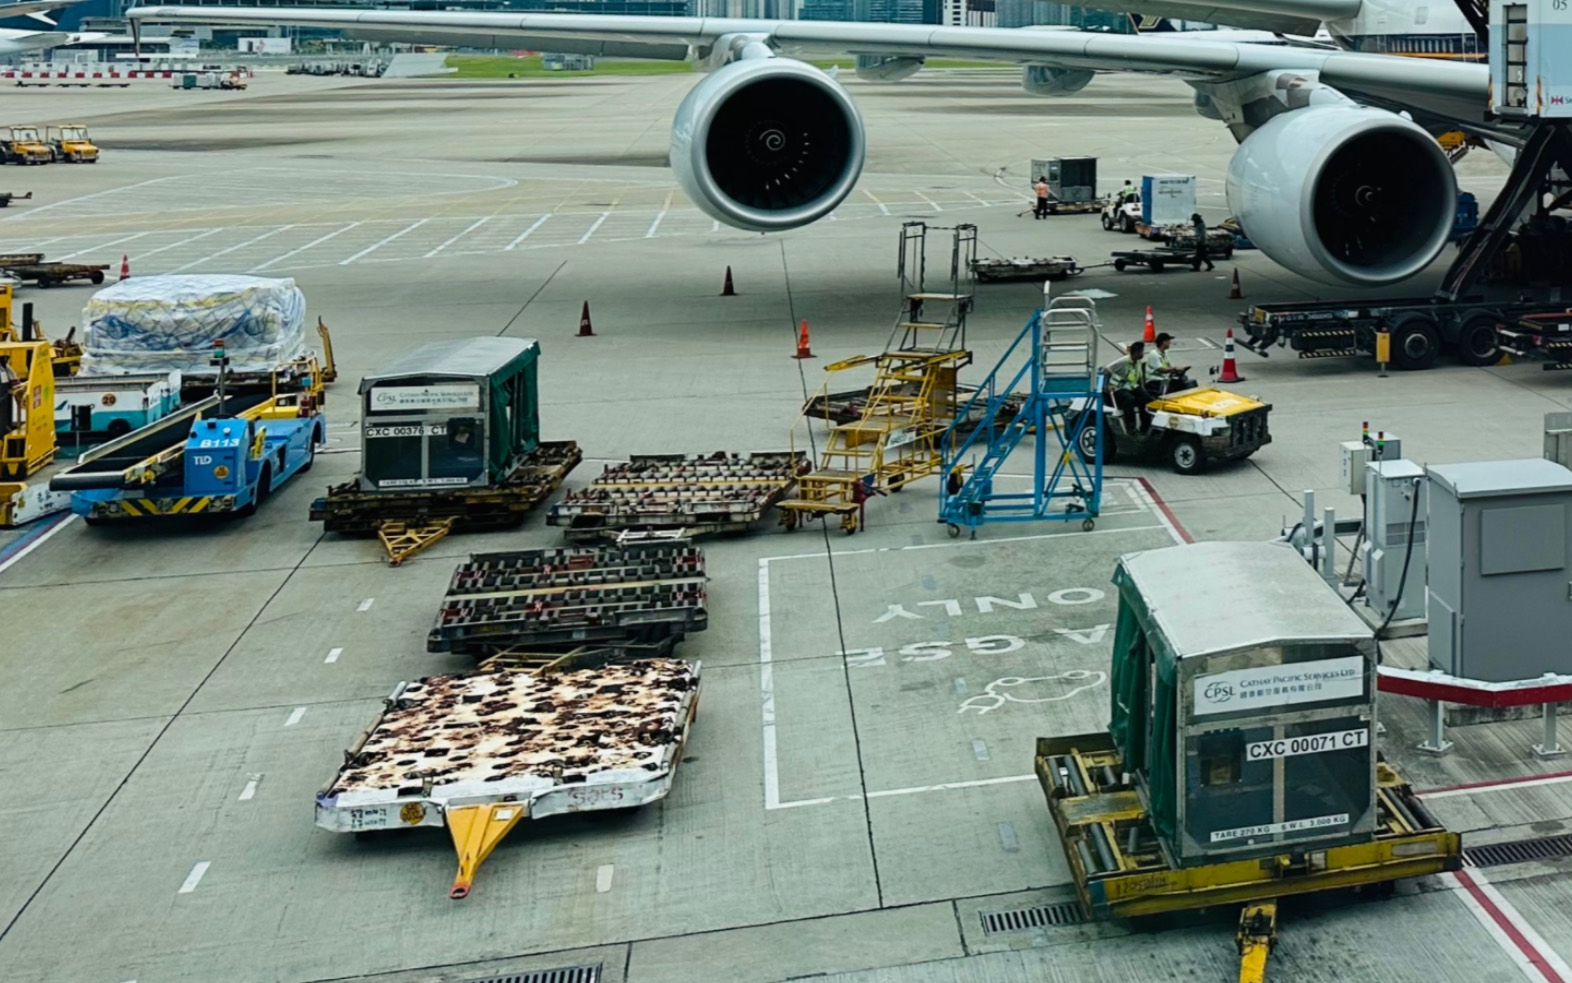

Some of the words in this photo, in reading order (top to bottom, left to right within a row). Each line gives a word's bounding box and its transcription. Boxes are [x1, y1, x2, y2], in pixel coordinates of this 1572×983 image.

[366, 427, 390, 436] CXC
[394, 426, 425, 435] 00376
[431, 425, 447, 434] CT
[200, 439, 240, 448] B113
[193, 455, 212, 465] TLD
[872, 587, 1105, 624] ONLY
[836, 634, 1025, 669] GSE
[1240, 678, 1272, 689] CATHAY
[1273, 674, 1302, 685] PACIFIC
[1304, 670, 1340, 681] SERVICES
[1341, 668, 1356, 677] LTD
[1204, 686, 1236, 701] CPSL
[1250, 741, 1285, 759] CXC
[1291, 735, 1336, 754] 00071
[1342, 730, 1365, 747] CT
[1214, 830, 1237, 840] TARE
[1257, 826, 1271, 834] KG
[1333, 816, 1347, 824] KG
